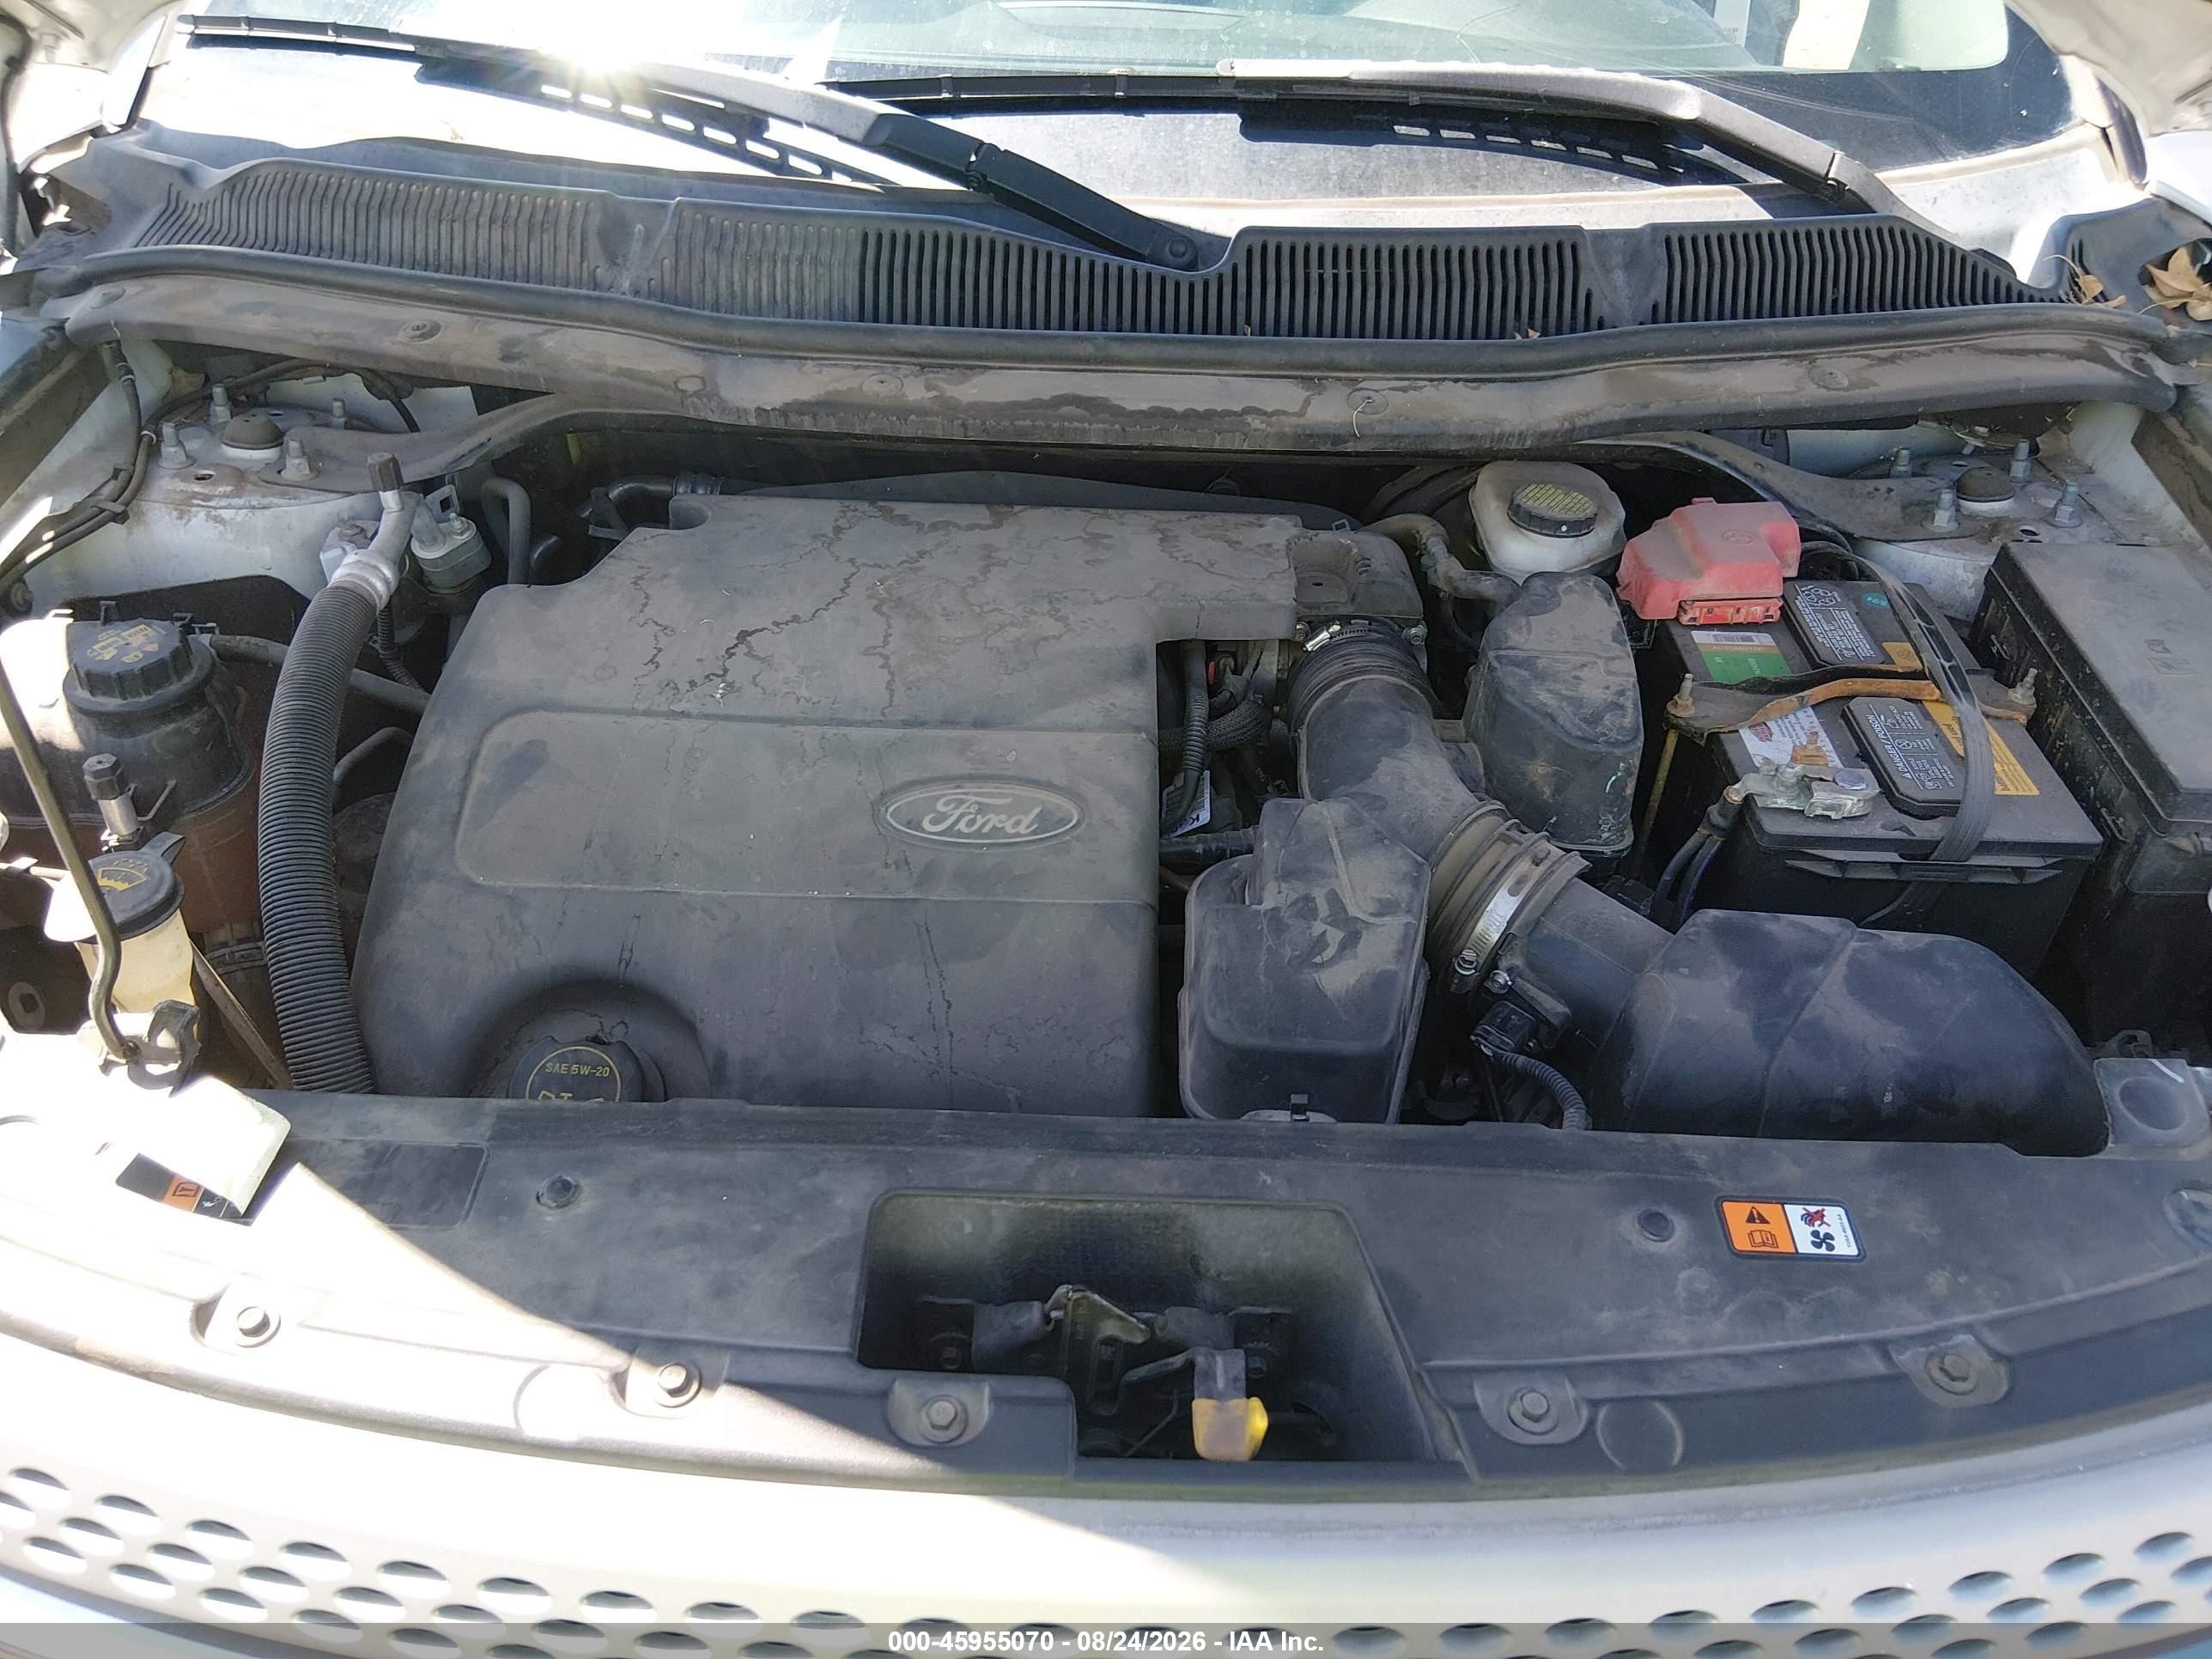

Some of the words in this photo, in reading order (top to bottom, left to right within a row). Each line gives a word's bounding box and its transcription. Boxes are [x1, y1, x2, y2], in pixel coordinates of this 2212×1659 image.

[1867, 714, 1887, 738] POISON
[1885, 744, 1908, 772] DANGER
[921, 794, 1042, 834] Ford
[546, 1063, 568, 1074] SAE
[571, 1064, 611, 1077] 5W-20
